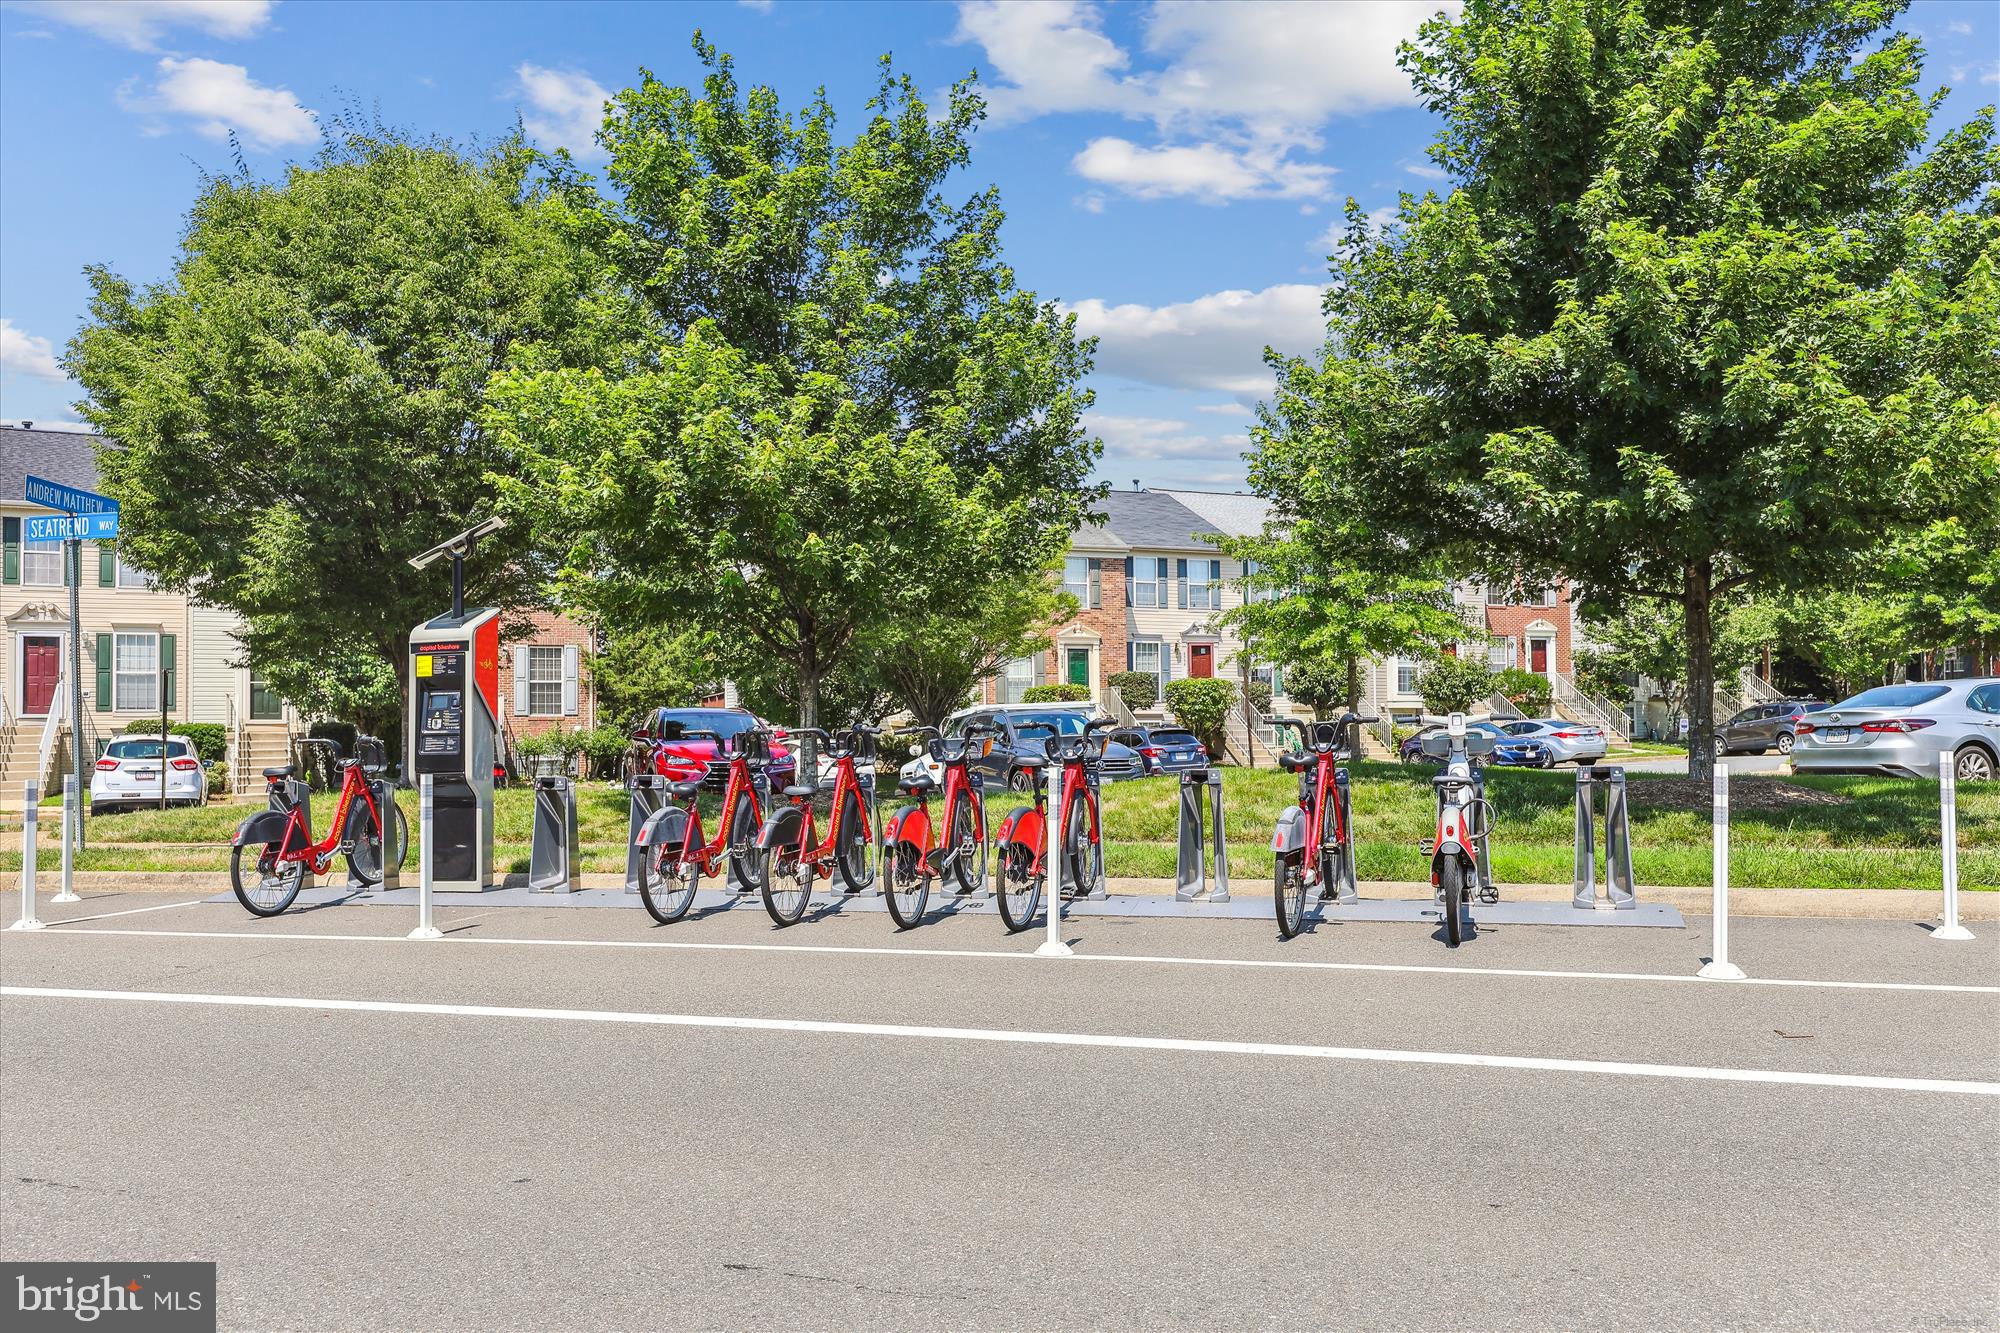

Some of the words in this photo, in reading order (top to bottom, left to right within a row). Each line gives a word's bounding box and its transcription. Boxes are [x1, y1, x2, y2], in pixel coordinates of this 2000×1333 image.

[27, 481, 62, 506] ANDREW
[63, 492, 104, 513] MATTHEW
[31, 518, 89, 538] SEATREND
[99, 521, 114, 531] WAY
[728, 776, 741, 811] bikeshare
[334, 815, 345, 842] capital
[341, 781, 355, 814] bikeshare
